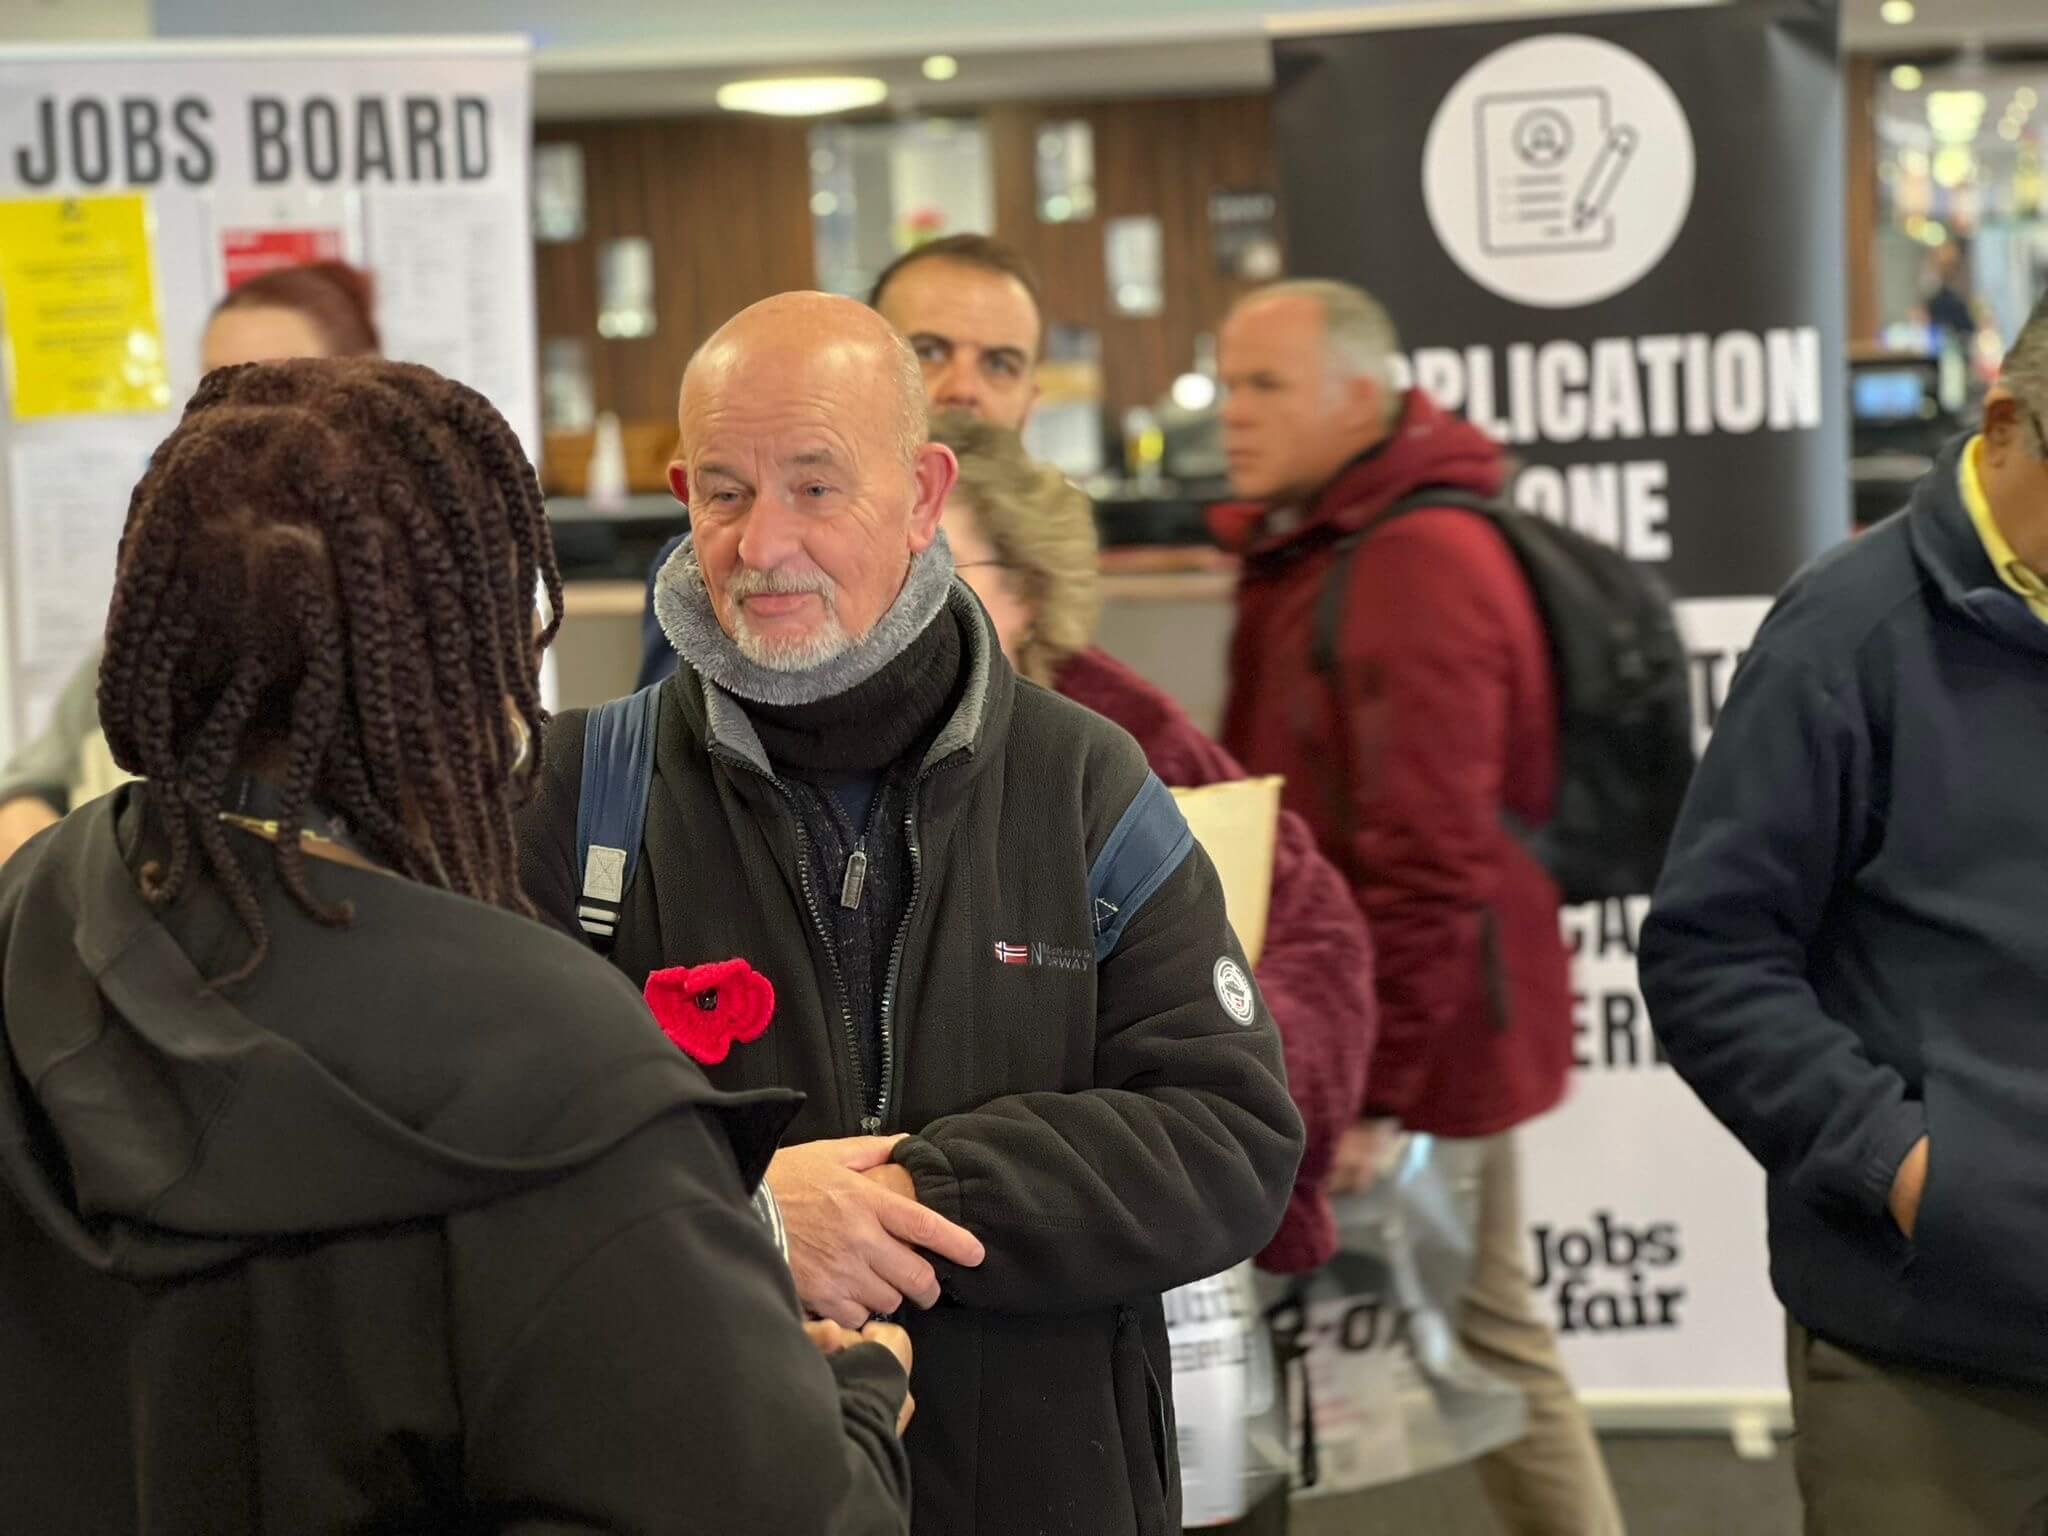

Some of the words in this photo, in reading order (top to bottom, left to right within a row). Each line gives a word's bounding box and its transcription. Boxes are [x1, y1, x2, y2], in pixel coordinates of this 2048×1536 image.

[16, 93, 216, 187] JOBS
[251, 93, 490, 184] BOARD
[1558, 1272, 1686, 1333] fair
